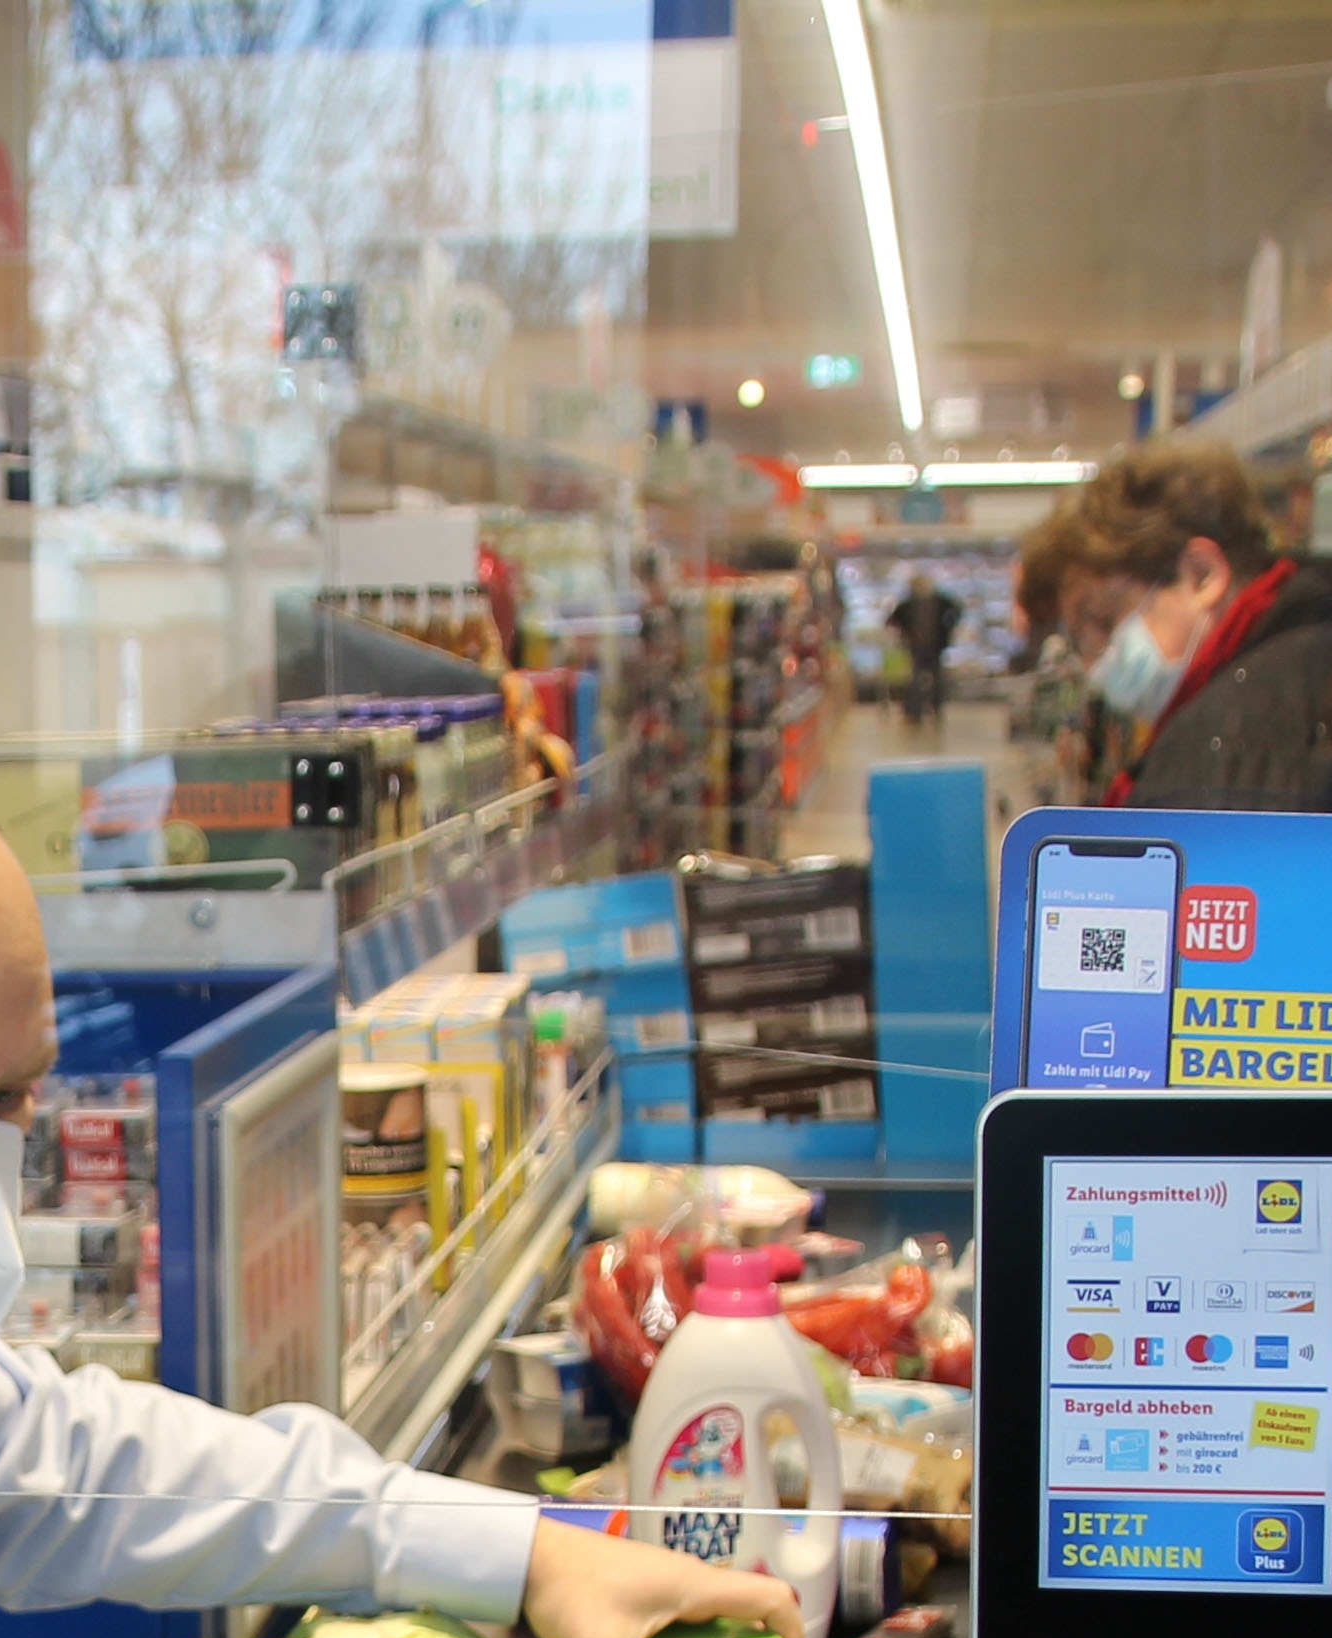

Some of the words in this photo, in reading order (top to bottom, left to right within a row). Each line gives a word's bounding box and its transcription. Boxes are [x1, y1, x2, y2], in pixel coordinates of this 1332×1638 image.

[1187, 899, 1249, 921] JETZT
[1185, 922, 1247, 951] NEU
[1182, 997, 1266, 1029] MIT
[1043, 1062, 1077, 1078] Zahle
[1079, 1064, 1101, 1079] mit
[1103, 1065, 1126, 1080] Lidl
[1128, 1068, 1152, 1082] Pay
[1066, 1186, 1202, 1205] Zahlungsmittel
[1069, 1243, 1111, 1256] girocard
[1074, 1287, 1114, 1302] VISA
[1155, 1281, 1173, 1297] V
[1152, 1301, 1174, 1312] PAY
[1064, 1398, 1133, 1418] Bargeld
[1137, 1400, 1213, 1416] abheben
[1265, 1407, 1279, 1418] Ab
[1281, 1409, 1306, 1420] einem
[1257, 1419, 1312, 1434] Einkaufswert
[1176, 1430, 1244, 1444] gebührenfrei
[1260, 1434, 1276, 1444] von
[1285, 1435, 1305, 1446] Euro
[1065, 1453, 1104, 1466] girocard
[1176, 1446, 1193, 1458] mit
[1195, 1447, 1238, 1461] girocard
[1176, 1462, 1191, 1475] bis
[1192, 1464, 1213, 1475] 200
[1214, 1464, 1223, 1475] €
[1062, 1511, 1149, 1536] JETZT
[1061, 1543, 1204, 1569] SCANNEN
[1254, 1554, 1286, 1571] Plus
